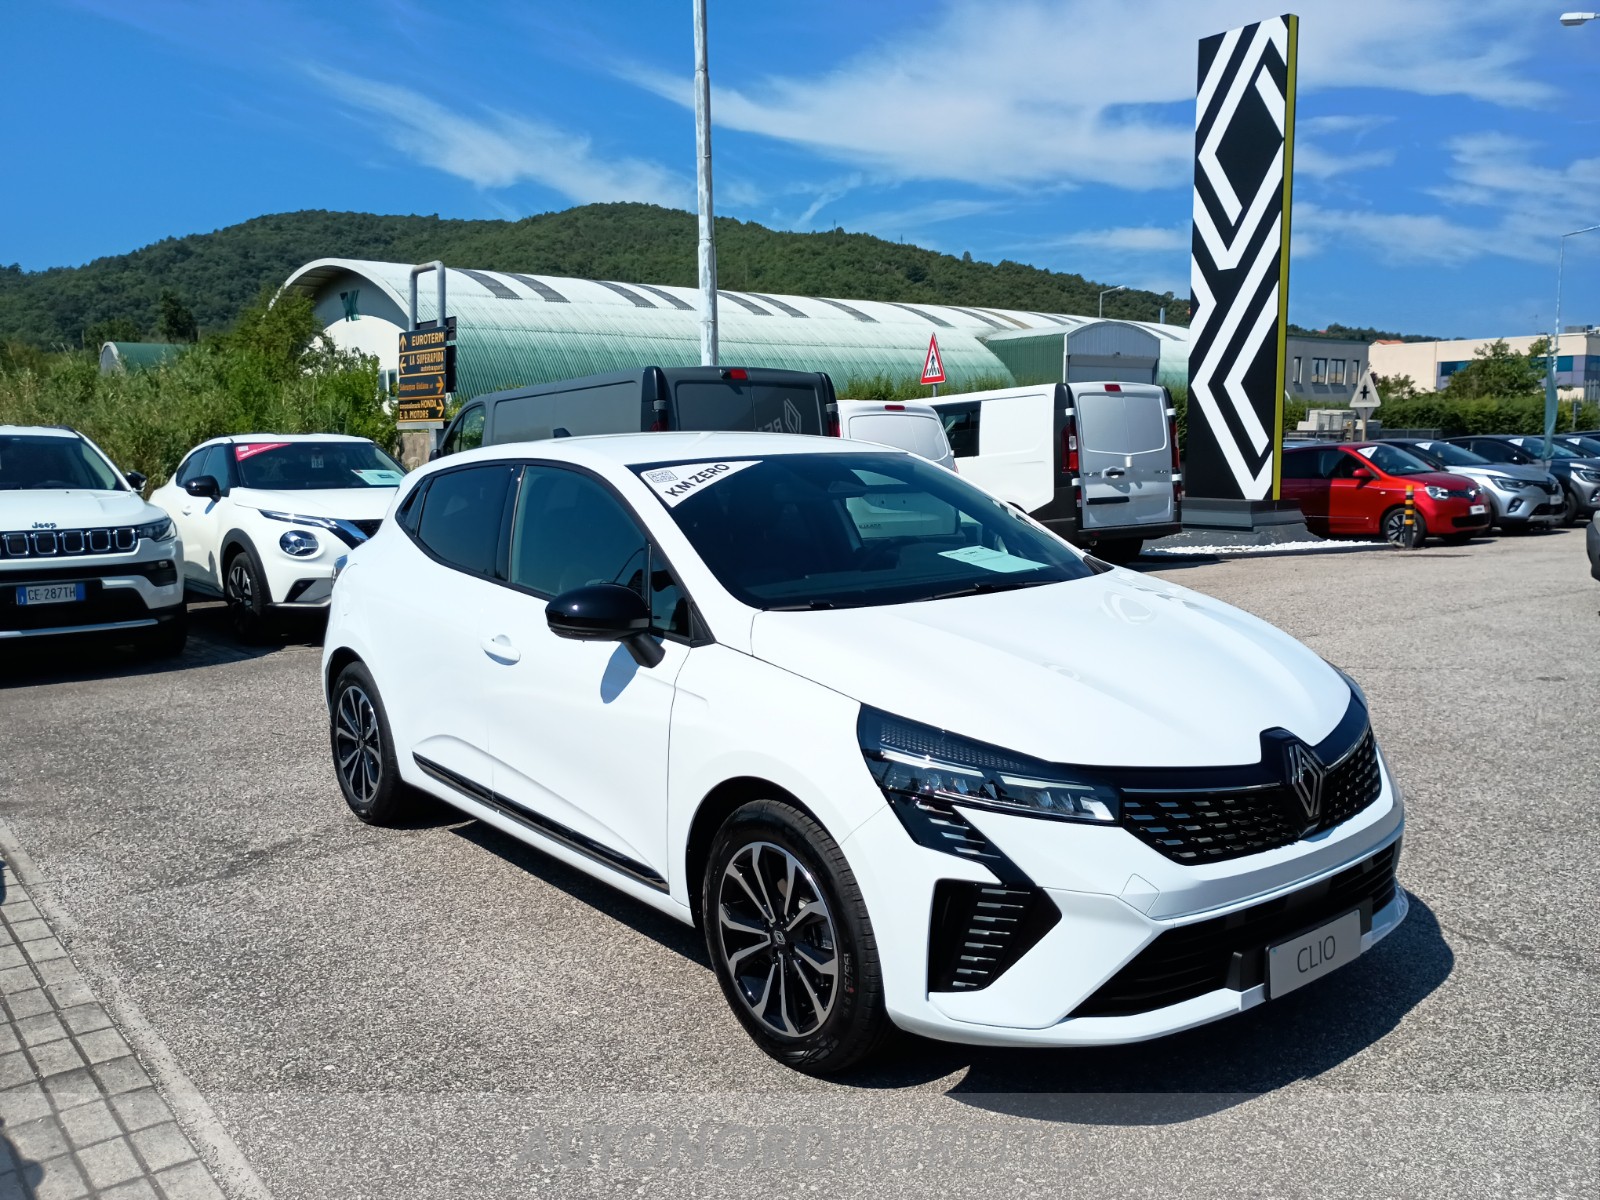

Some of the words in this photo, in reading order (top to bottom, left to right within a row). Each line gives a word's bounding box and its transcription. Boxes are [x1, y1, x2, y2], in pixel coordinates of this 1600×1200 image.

[412, 332, 445, 347] EUROTERM
[410, 354, 416, 365] LA
[416, 351, 444, 364] SUPERAPIDA
[420, 398, 437, 409] HONDA
[409, 410, 429, 419] MOTORS
[665, 480, 697, 497] KM
[688, 463, 730, 484] ZERO
[31, 521, 57, 530] Jeep
[1297, 935, 1336, 974] CLIO
